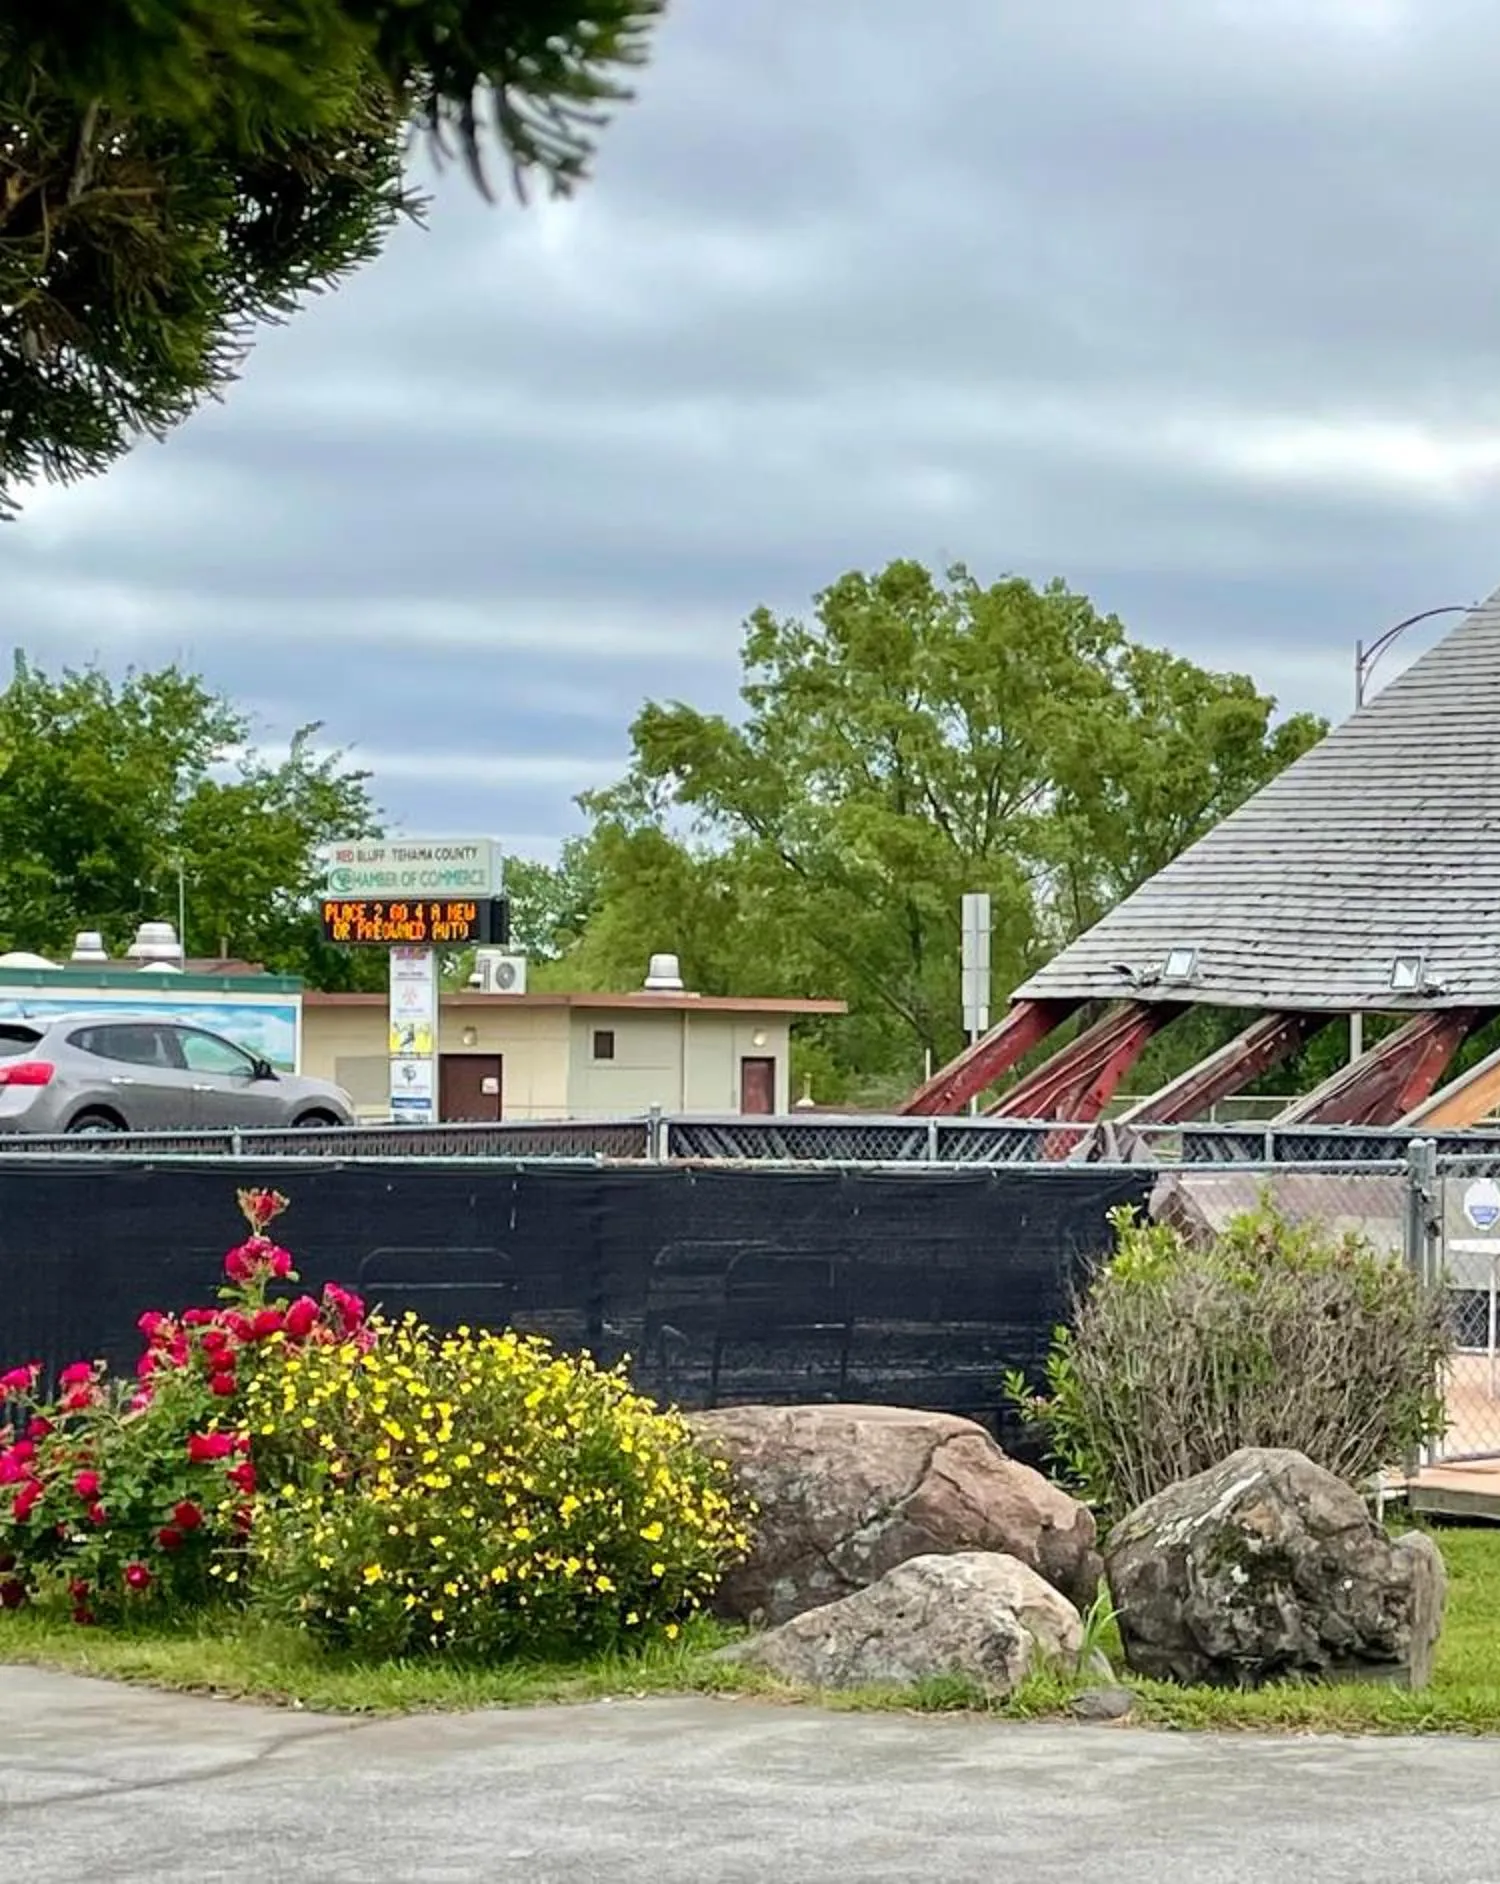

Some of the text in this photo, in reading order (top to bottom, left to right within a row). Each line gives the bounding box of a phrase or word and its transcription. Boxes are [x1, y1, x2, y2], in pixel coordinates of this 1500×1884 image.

[358, 848, 385, 862] BLUFF
[392, 847, 432, 861] TEHAMA
[434, 846, 478, 861] COUNTY
[401, 871, 417, 887] OF
[420, 869, 485, 887] COMMERCE
[374, 903, 383, 922] 2
[431, 903, 441, 921] A
[447, 902, 476, 920] NEW
[432, 921, 469, 940] AUTO
